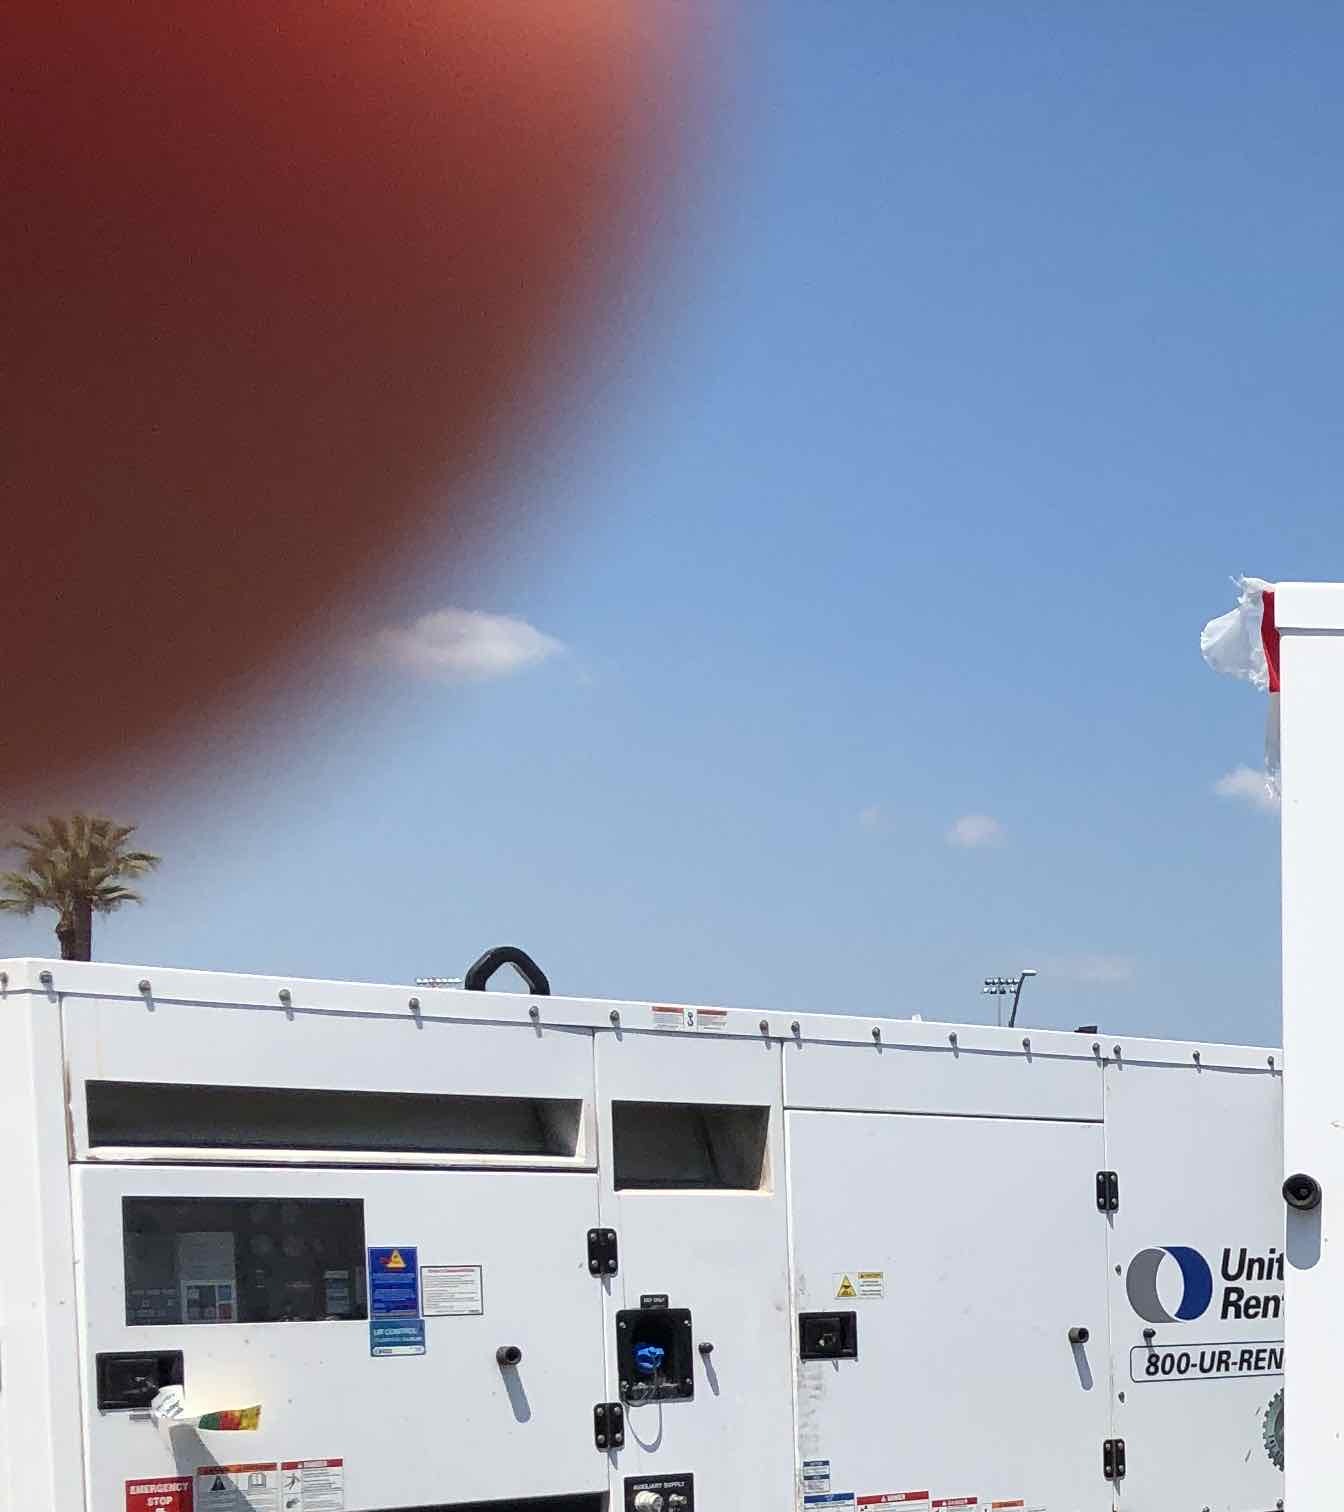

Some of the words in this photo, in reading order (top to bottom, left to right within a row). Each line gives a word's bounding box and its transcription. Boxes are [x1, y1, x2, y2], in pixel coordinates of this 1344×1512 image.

[1220, 1286, 1284, 1320] Ren
[129, 1482, 189, 1495] EMERGENCY
[147, 1496, 173, 1506] STOP
